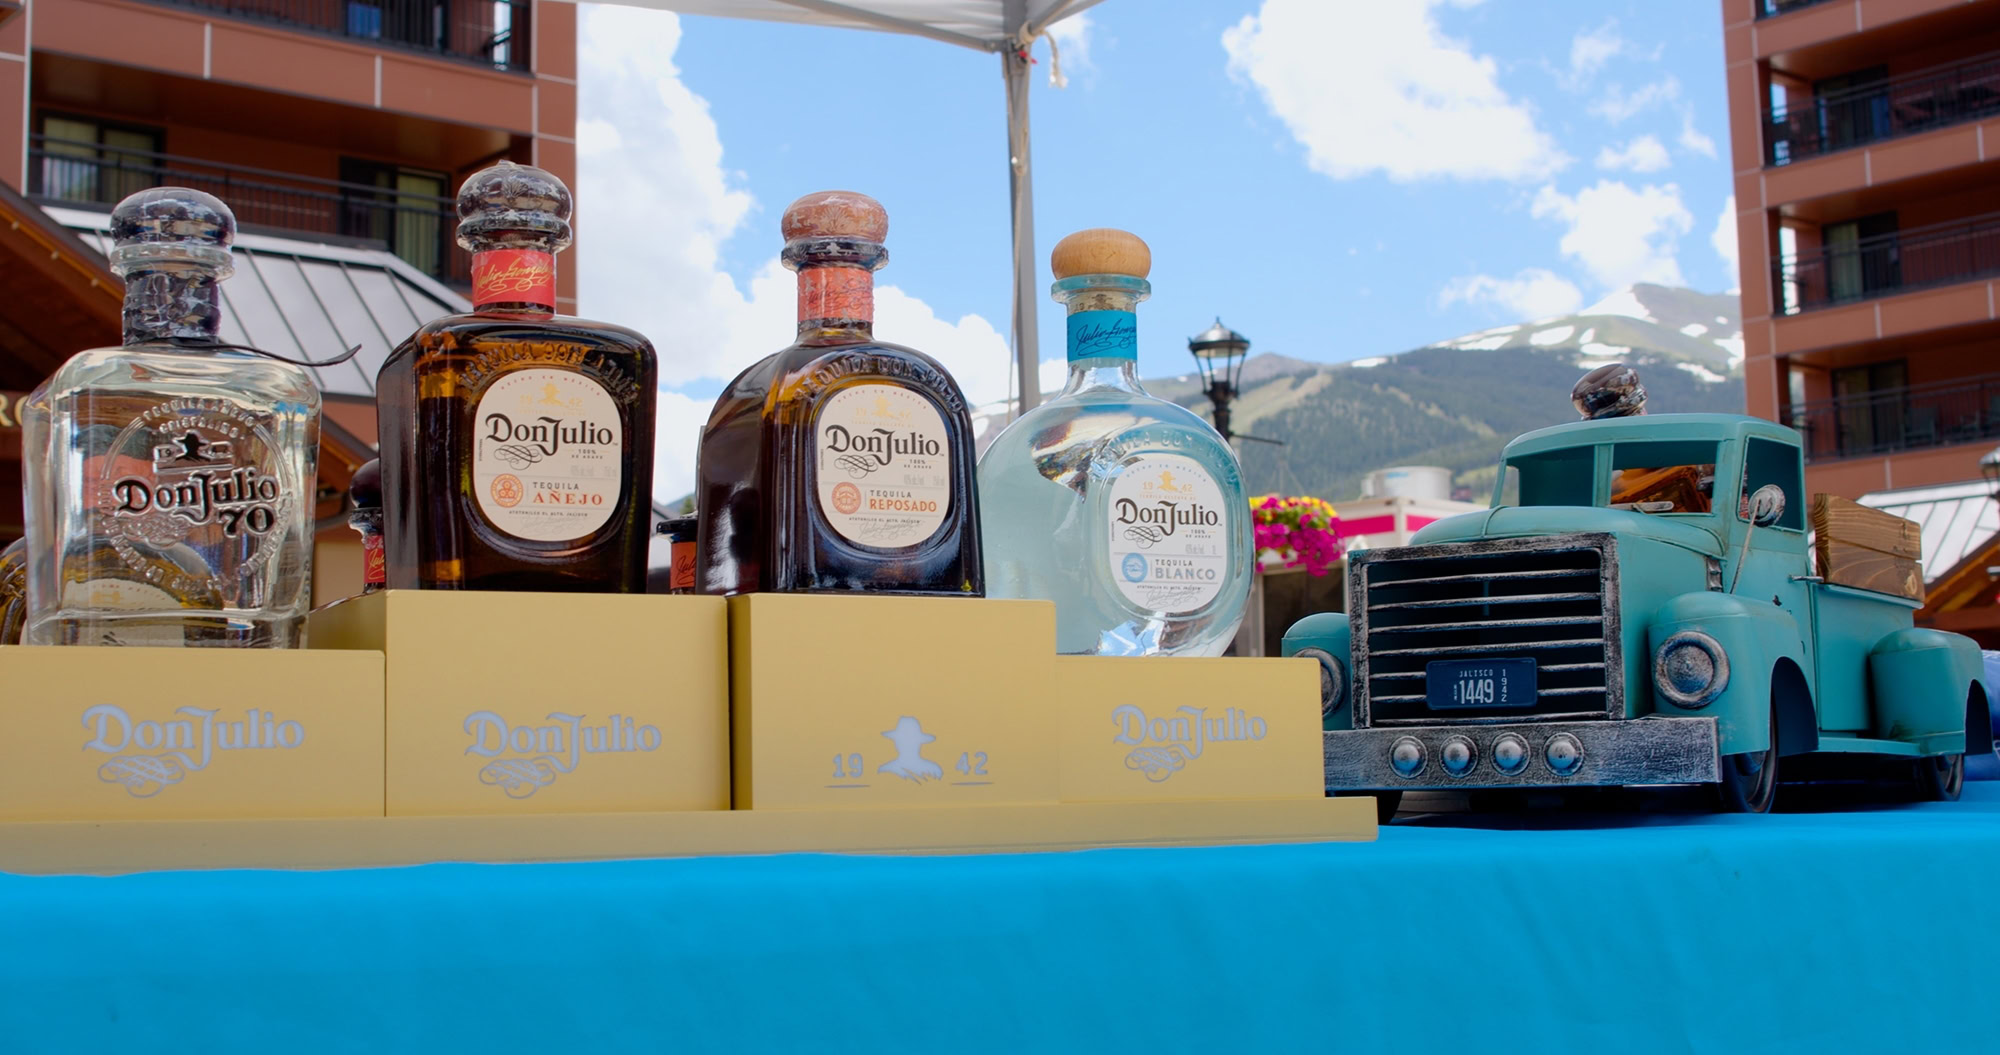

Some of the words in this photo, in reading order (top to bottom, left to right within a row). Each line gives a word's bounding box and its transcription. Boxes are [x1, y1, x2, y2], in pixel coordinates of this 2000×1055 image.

[532, 481, 581, 492] TEQUILA
[532, 490, 604, 507] AÑEJO
[869, 489, 913, 499] TEQUILA
[868, 498, 938, 513] REPOSADO
[217, 503, 276, 538] 70
[1154, 559, 1194, 567] TEQUILA
[1155, 567, 1217, 581] BLANCO
[1459, 669, 1494, 677] JALISCO
[1459, 679, 1494, 704] 1449
[832, 752, 864, 778] 19
[954, 751, 990, 776] 42
